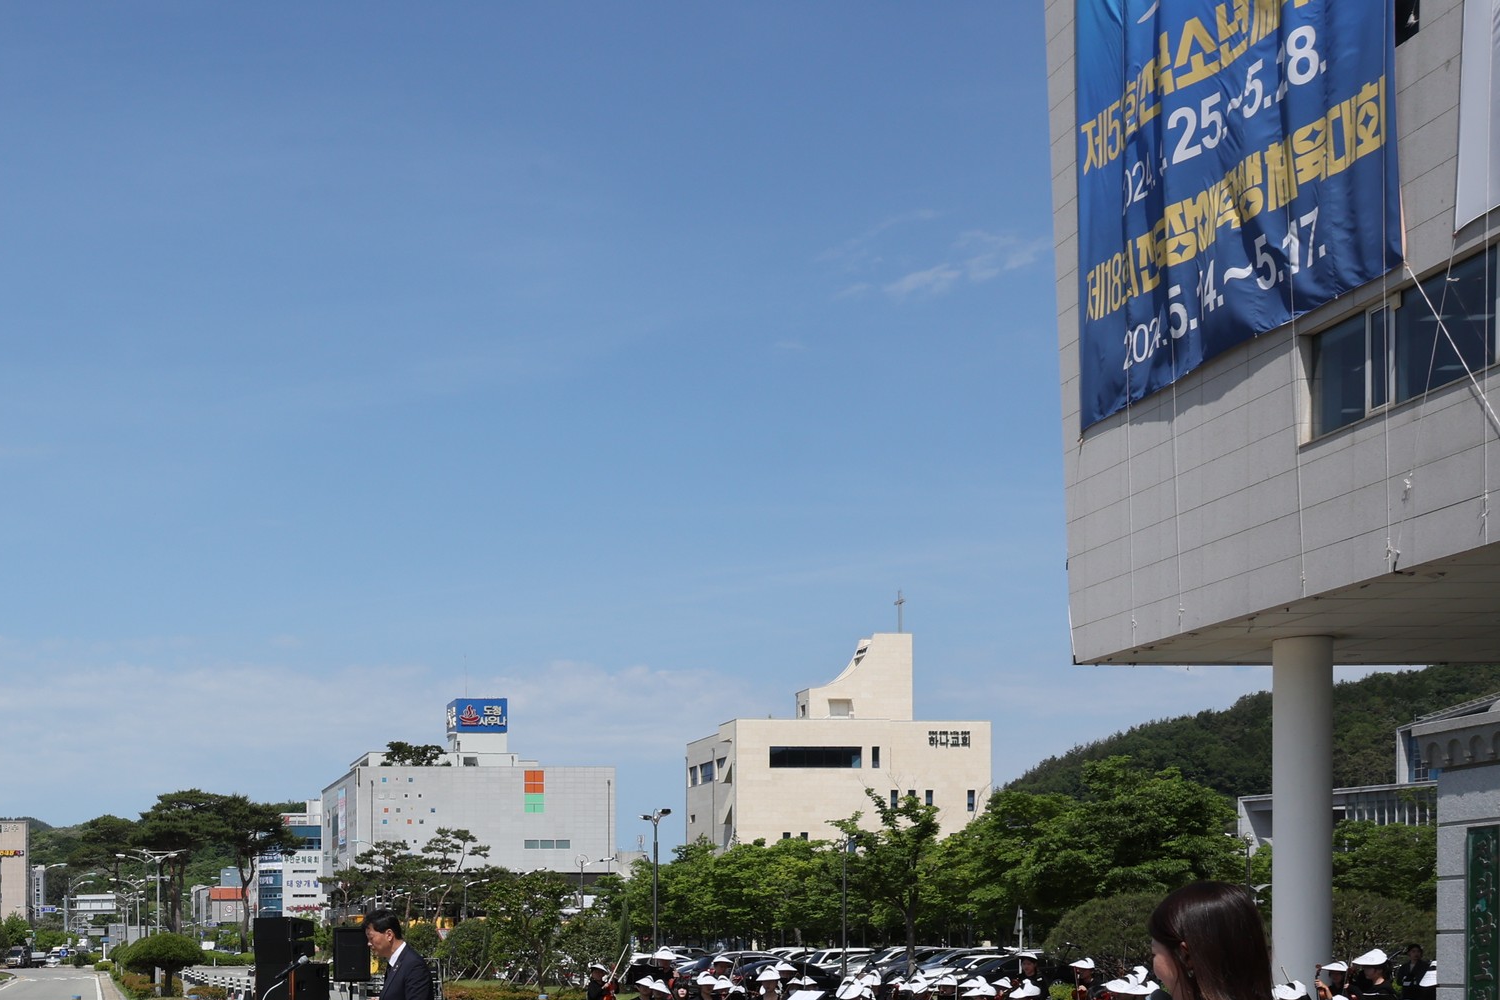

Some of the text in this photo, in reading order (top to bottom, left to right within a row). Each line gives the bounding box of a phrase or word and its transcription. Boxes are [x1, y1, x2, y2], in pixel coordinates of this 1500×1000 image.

[483, 705, 502, 716] 도청
[479, 716, 507, 727] 사우나
[928, 735, 971, 749] 하나교회
[286, 879, 319, 888] 태양개발
